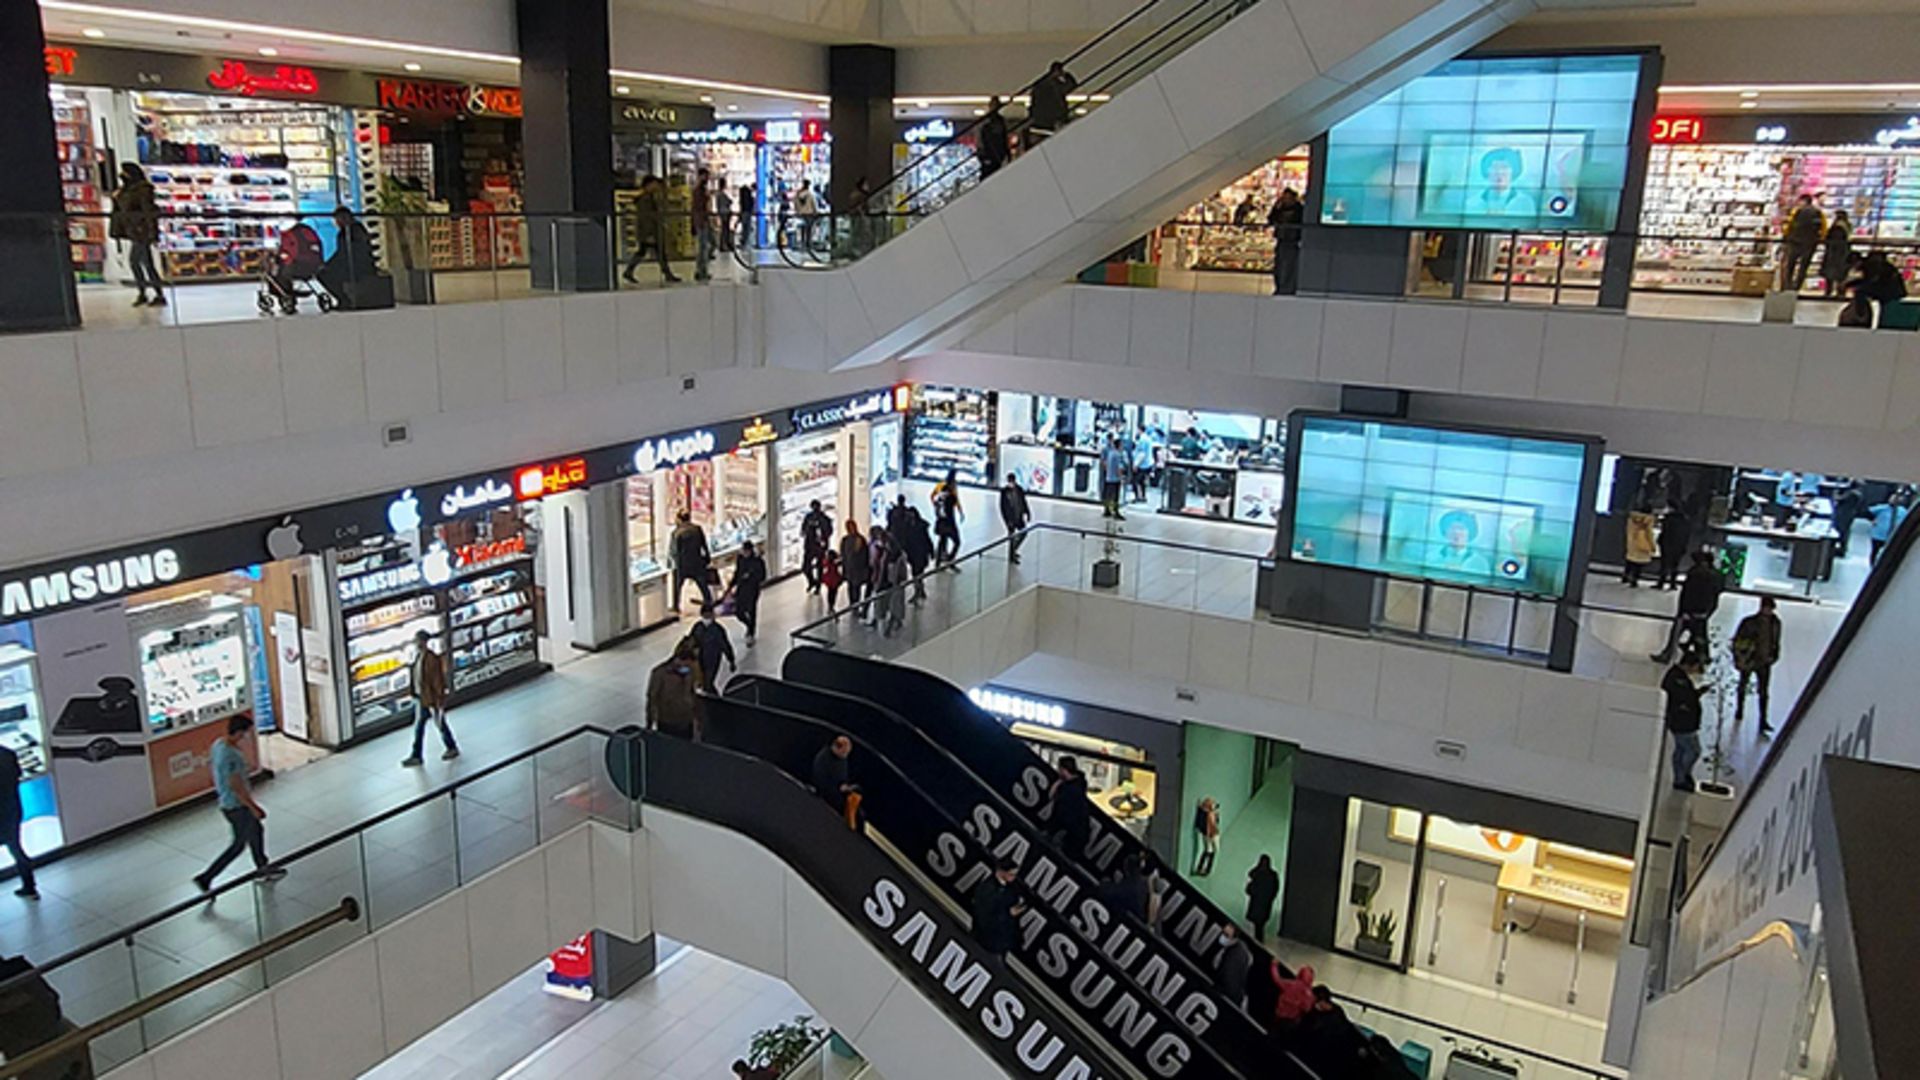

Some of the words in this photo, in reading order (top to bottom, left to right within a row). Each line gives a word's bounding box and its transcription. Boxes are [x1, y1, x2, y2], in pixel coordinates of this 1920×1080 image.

[656, 430, 714, 463] Apple
[339, 563, 421, 599] SAMSUNG
[968, 687, 1065, 728] SAMSUNG
[964, 804, 1218, 1036] SAMSUNG
